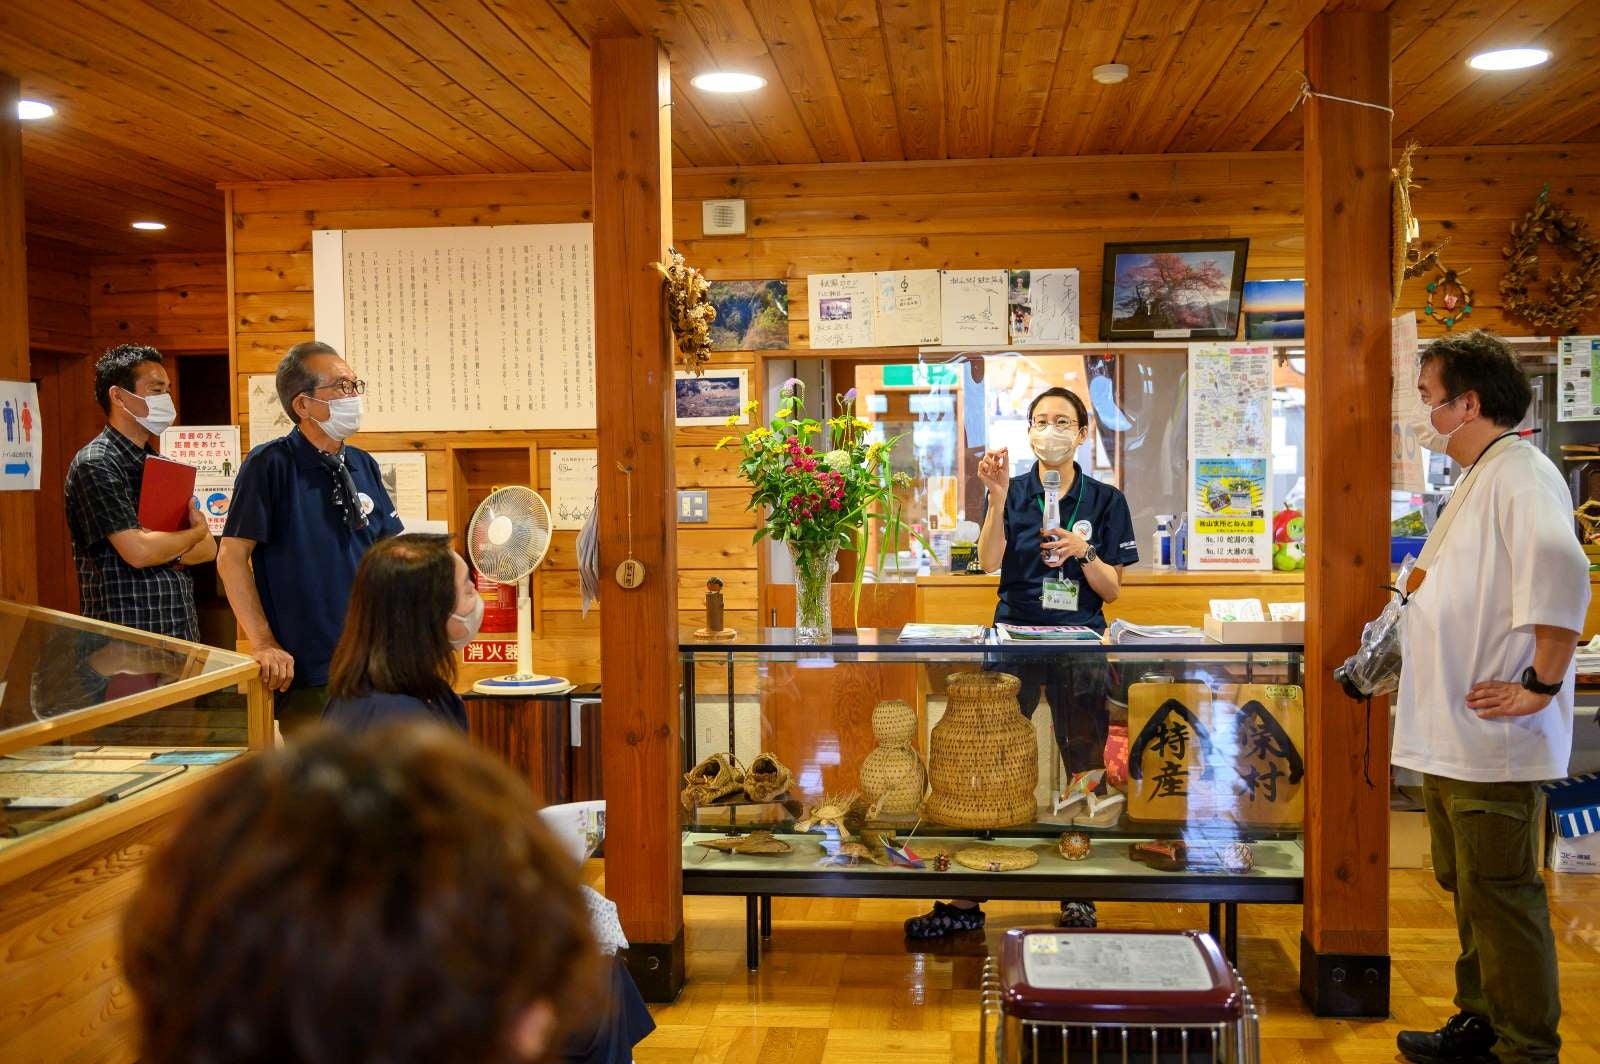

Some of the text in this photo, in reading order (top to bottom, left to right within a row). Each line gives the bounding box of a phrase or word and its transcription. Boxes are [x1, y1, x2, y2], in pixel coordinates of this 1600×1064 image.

[174, 441, 226, 449] 距離をあけて
[467, 643, 519, 661] 消火器
[1147, 720, 1191, 802] 特産
